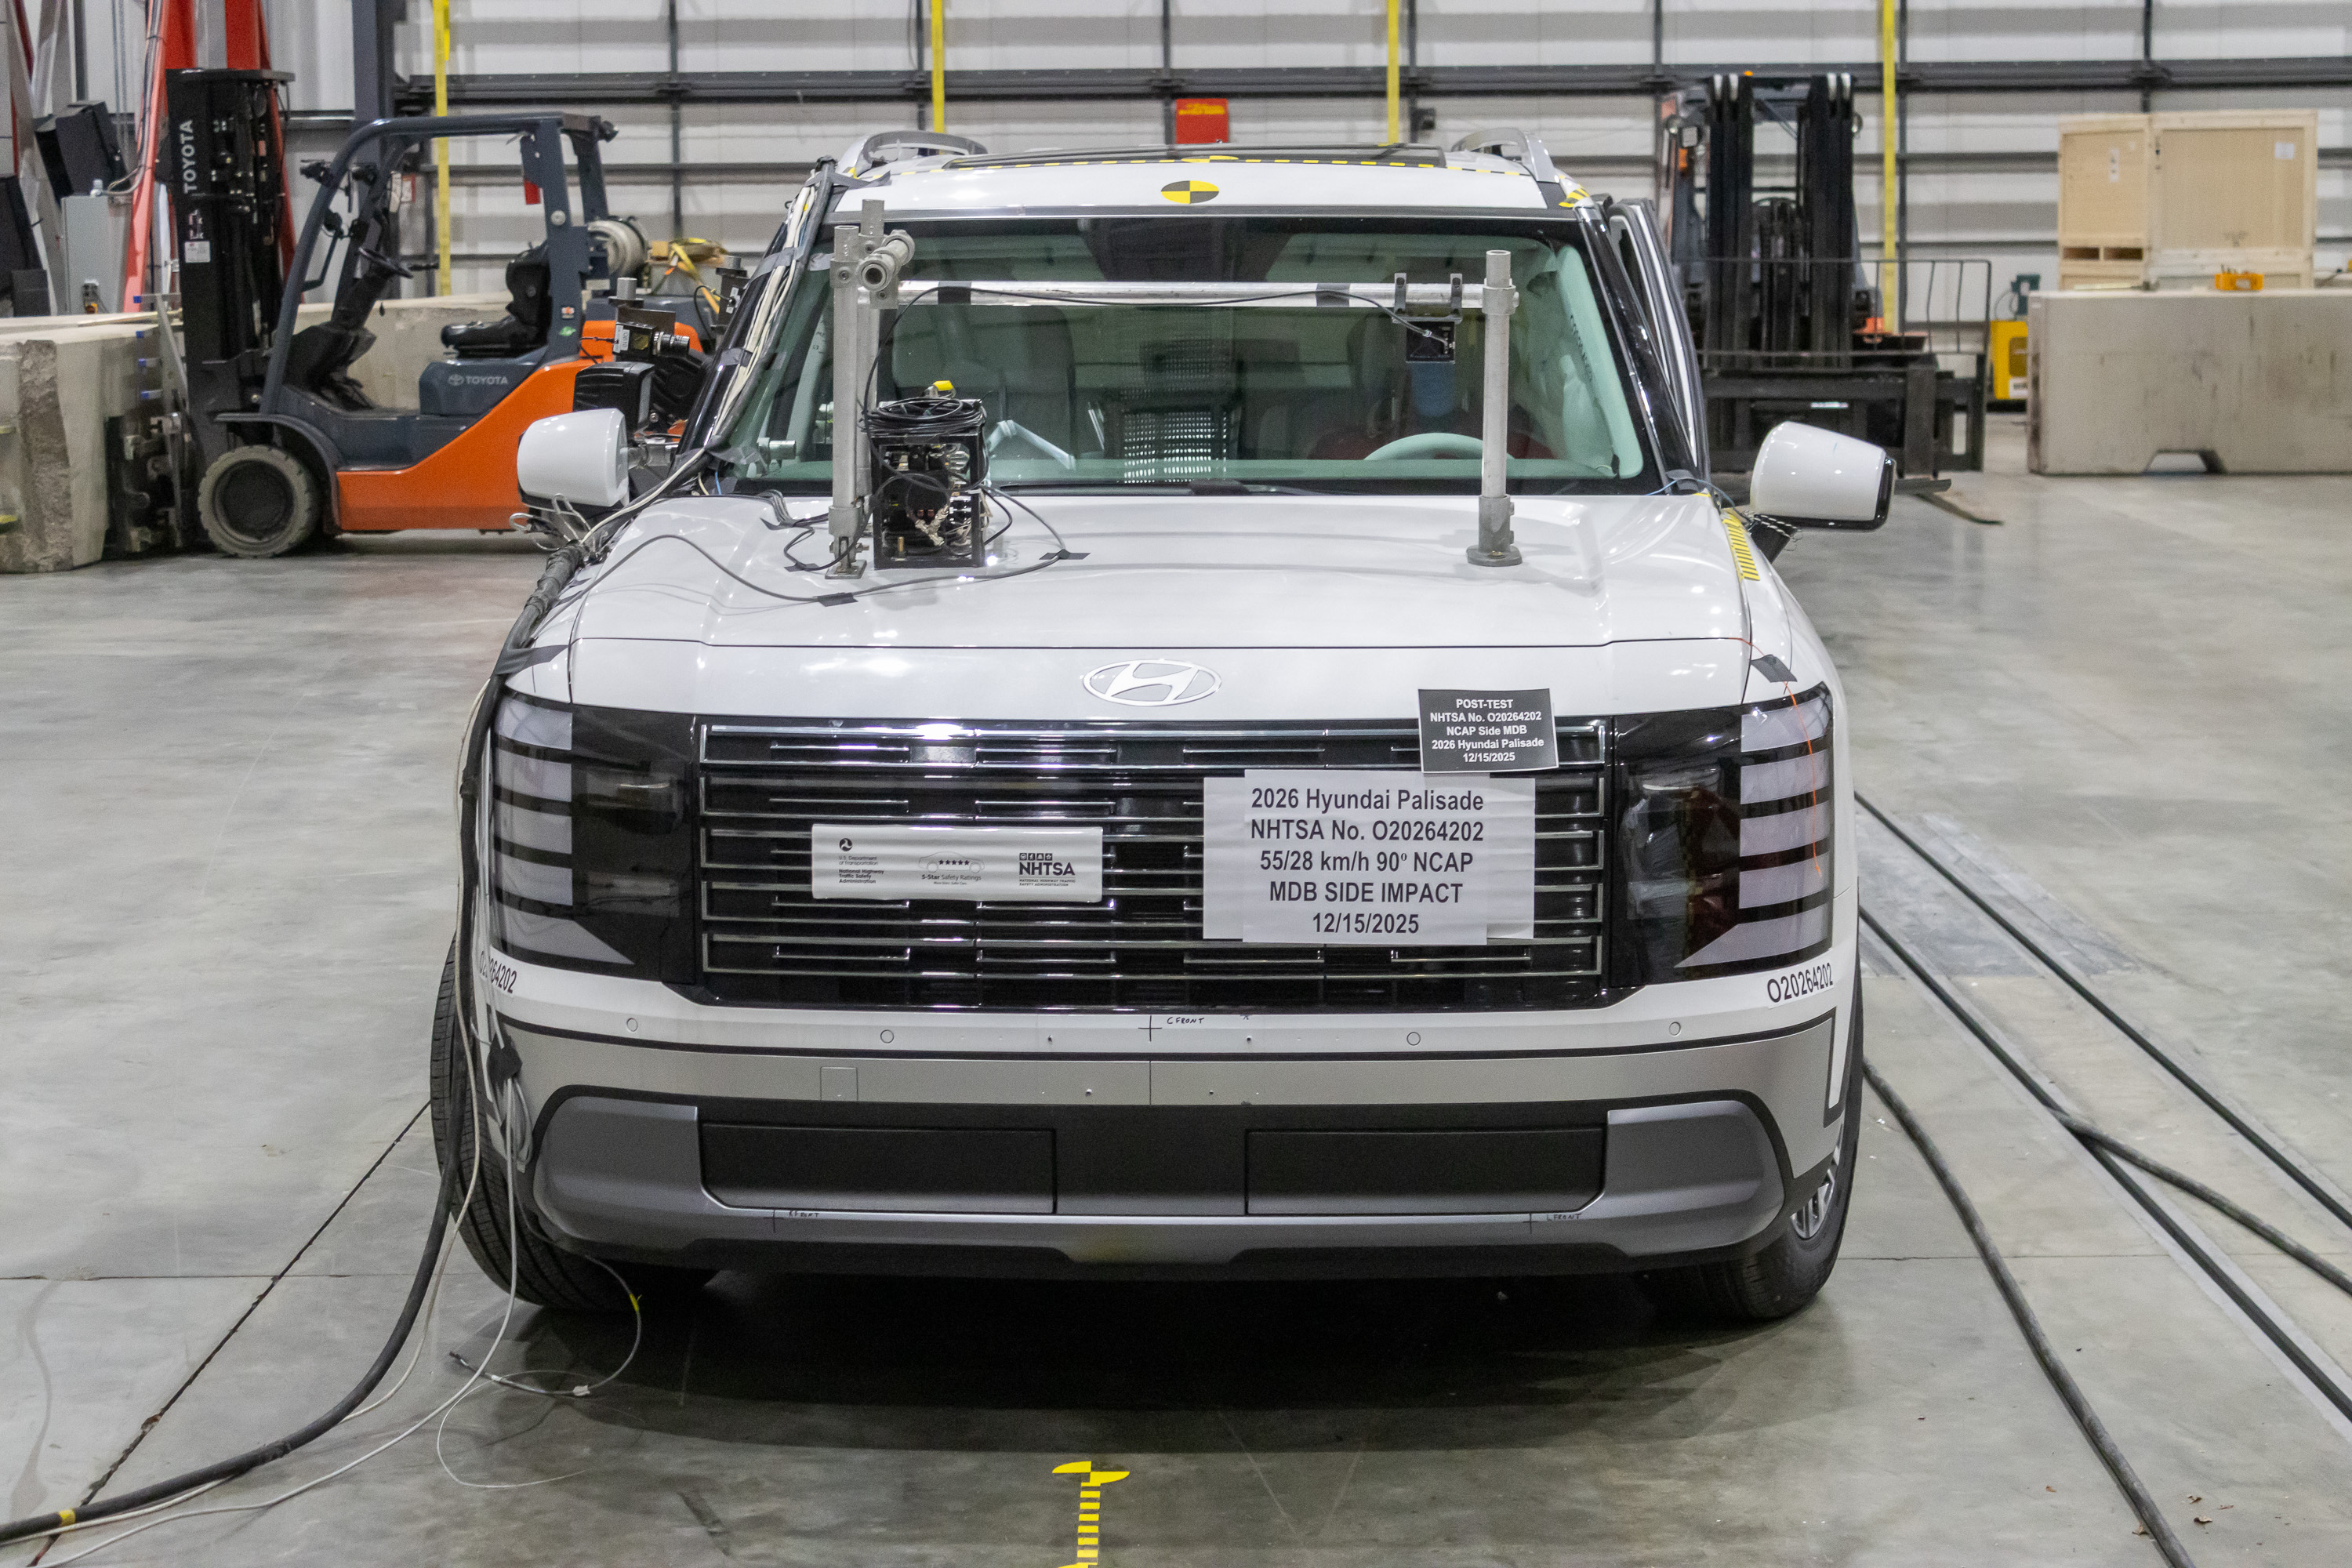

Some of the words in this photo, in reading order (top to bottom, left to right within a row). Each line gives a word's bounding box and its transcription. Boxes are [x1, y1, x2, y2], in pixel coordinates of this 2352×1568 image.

[180, 119, 197, 194] TOYOTA
[465, 376, 508, 385] TOYOTA
[1456, 699, 1513, 709] POST-TEST
[1430, 712, 1466, 722] NHTSA
[1468, 713, 1486, 722] No.
[1486, 711, 1542, 722] O20264202
[1446, 726, 1476, 736] NCAP
[1478, 726, 1501, 735] Side
[1503, 725, 1527, 735] MDB
[1432, 739, 1456, 750] 2026
[1457, 739, 1499, 751] Hyundai
[1501, 738, 1544, 748] Palisade
[1463, 752, 1516, 763] 12/15/2025
[1251, 788, 1299, 808] 2026
[1306, 789, 1390, 814] Hyundai
[1398, 789, 1484, 810] Palisade
[1251, 819, 1325, 840] NHTSA
[1331, 820, 1365, 840] No.
[1372, 821, 1484, 841] O20264202
[1019, 862, 1075, 876] NHTSA
[1260, 851, 1313, 870] 55/28
[1320, 851, 1370, 871] km/h
[1414, 852, 1473, 872] NCAP
[1269, 881, 1317, 902] MDB
[1324, 882, 1374, 902] SIDE
[1381, 883, 1464, 903] IMPACT
[1312, 913, 1419, 934] 12/15/2025
[1767, 962, 1834, 1003] O20264202
